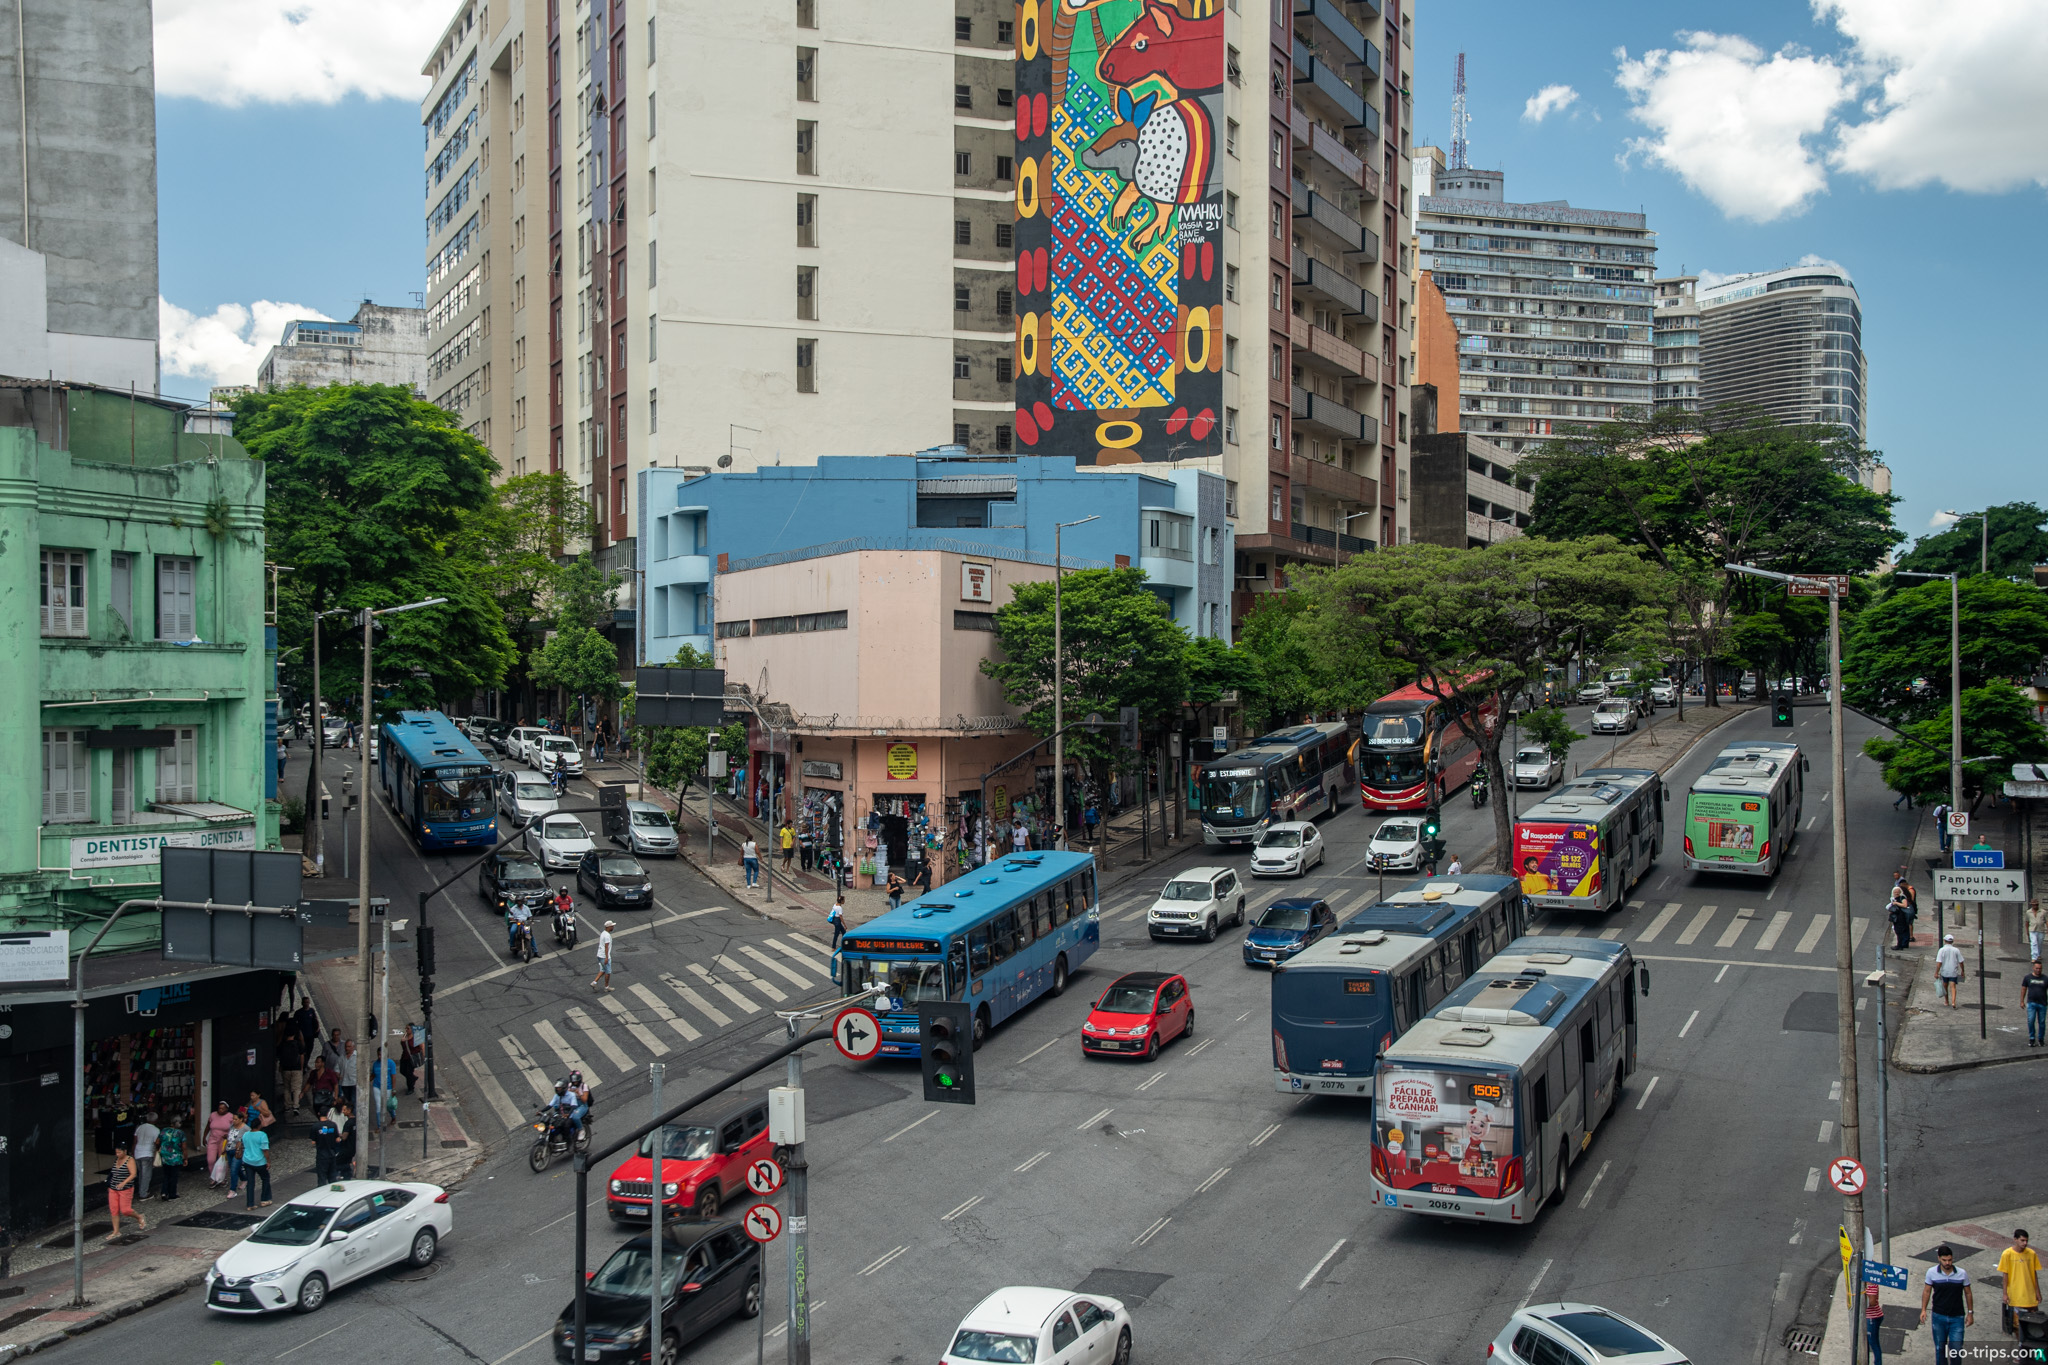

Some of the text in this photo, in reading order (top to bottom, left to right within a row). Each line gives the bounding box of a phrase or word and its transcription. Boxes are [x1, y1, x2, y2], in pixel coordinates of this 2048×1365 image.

[1178, 203, 1223, 222] MAHKU
[1206, 221, 1219, 231] 21
[201, 830, 244, 847] DENTISTA
[1530, 832, 1564, 840] Raspadinha
[1708, 821, 1722, 848] BH
[87, 836, 168, 854] DENTISTA
[80, 856, 109, 864] Consultório
[111, 853, 143, 863] Odontológico
[1570, 855, 1581, 863] 132
[1963, 855, 1994, 867] Tupis
[1939, 875, 2000, 885] Pampulha
[1951, 888, 2000, 896] Retorno
[16, 945, 64, 955] ASSOCIADOS
[18, 959, 65, 968] TRABALHISTA
[162, 982, 191, 1000] LIKE
[1320, 1081, 1345, 1089] 20776
[1394, 1085, 1432, 1097] FÁCIL DE
[1473, 1084, 1500, 1098] 1505
[1390, 1094, 1437, 1105] PREPARAR
[1389, 1101, 1439, 1113] & GANHAR!
[1428, 1200, 1461, 1211] 20876
